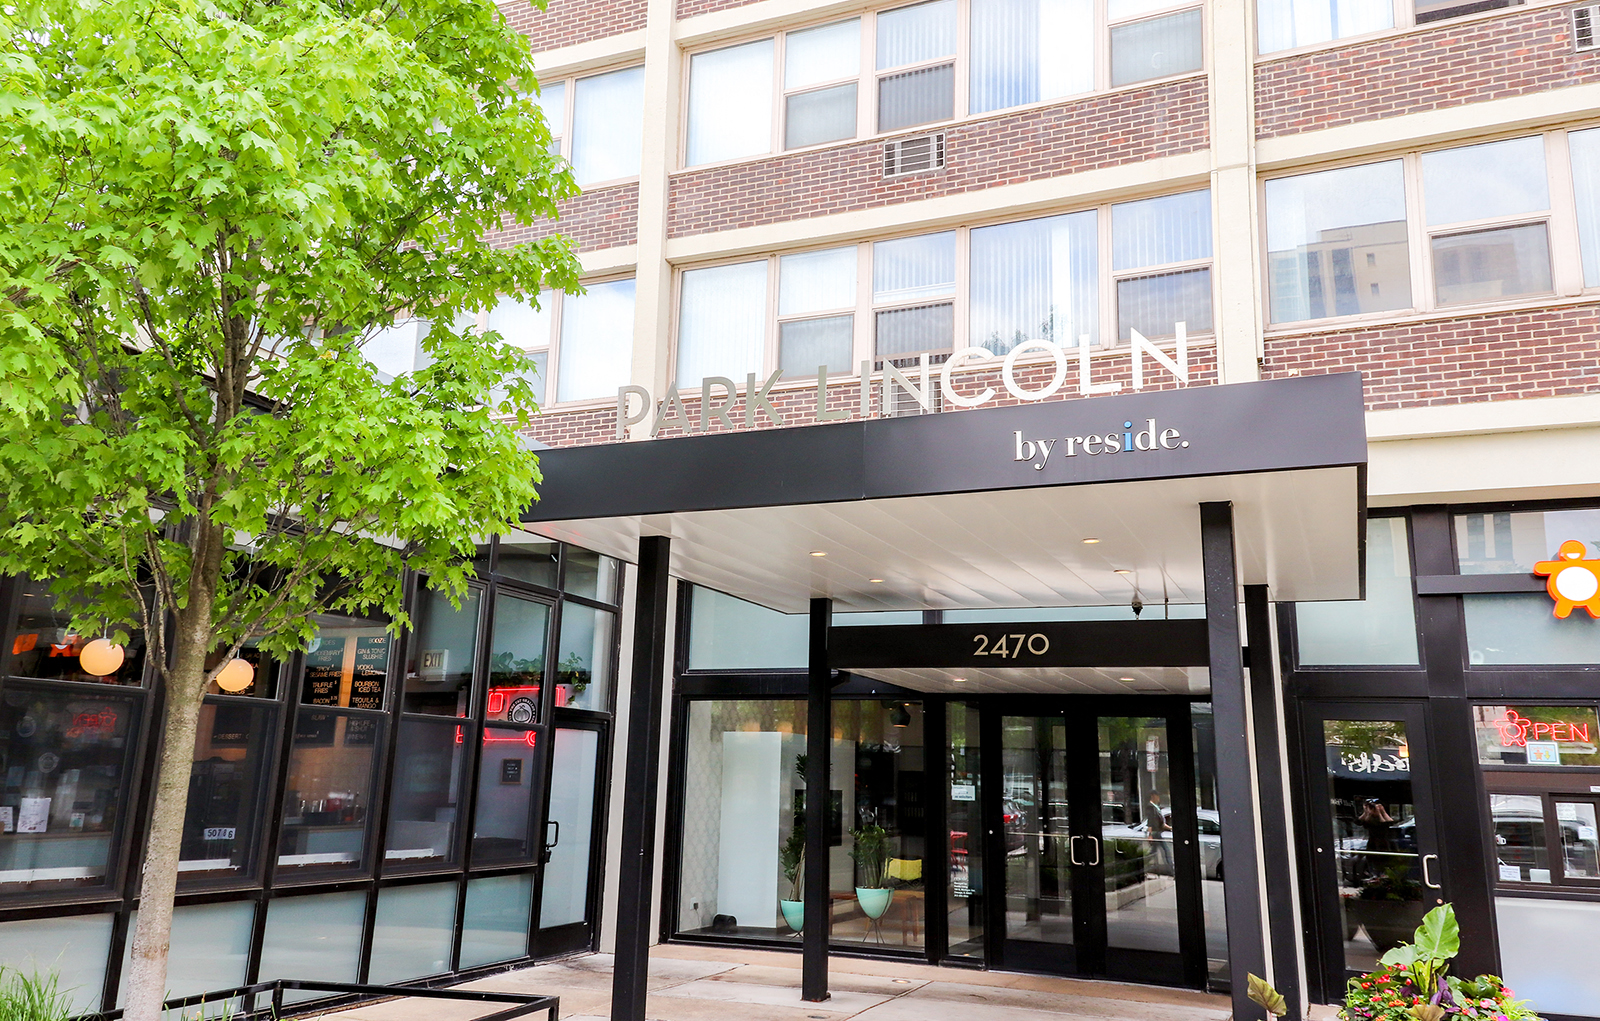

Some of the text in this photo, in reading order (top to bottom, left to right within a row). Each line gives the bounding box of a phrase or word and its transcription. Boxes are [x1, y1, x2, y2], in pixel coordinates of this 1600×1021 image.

[617, 321, 1190, 439] PARK LINCOLN
[1014, 419, 1190, 470] by reside.
[423, 652, 443, 667] EXIT
[973, 633, 1050, 659] 2470
